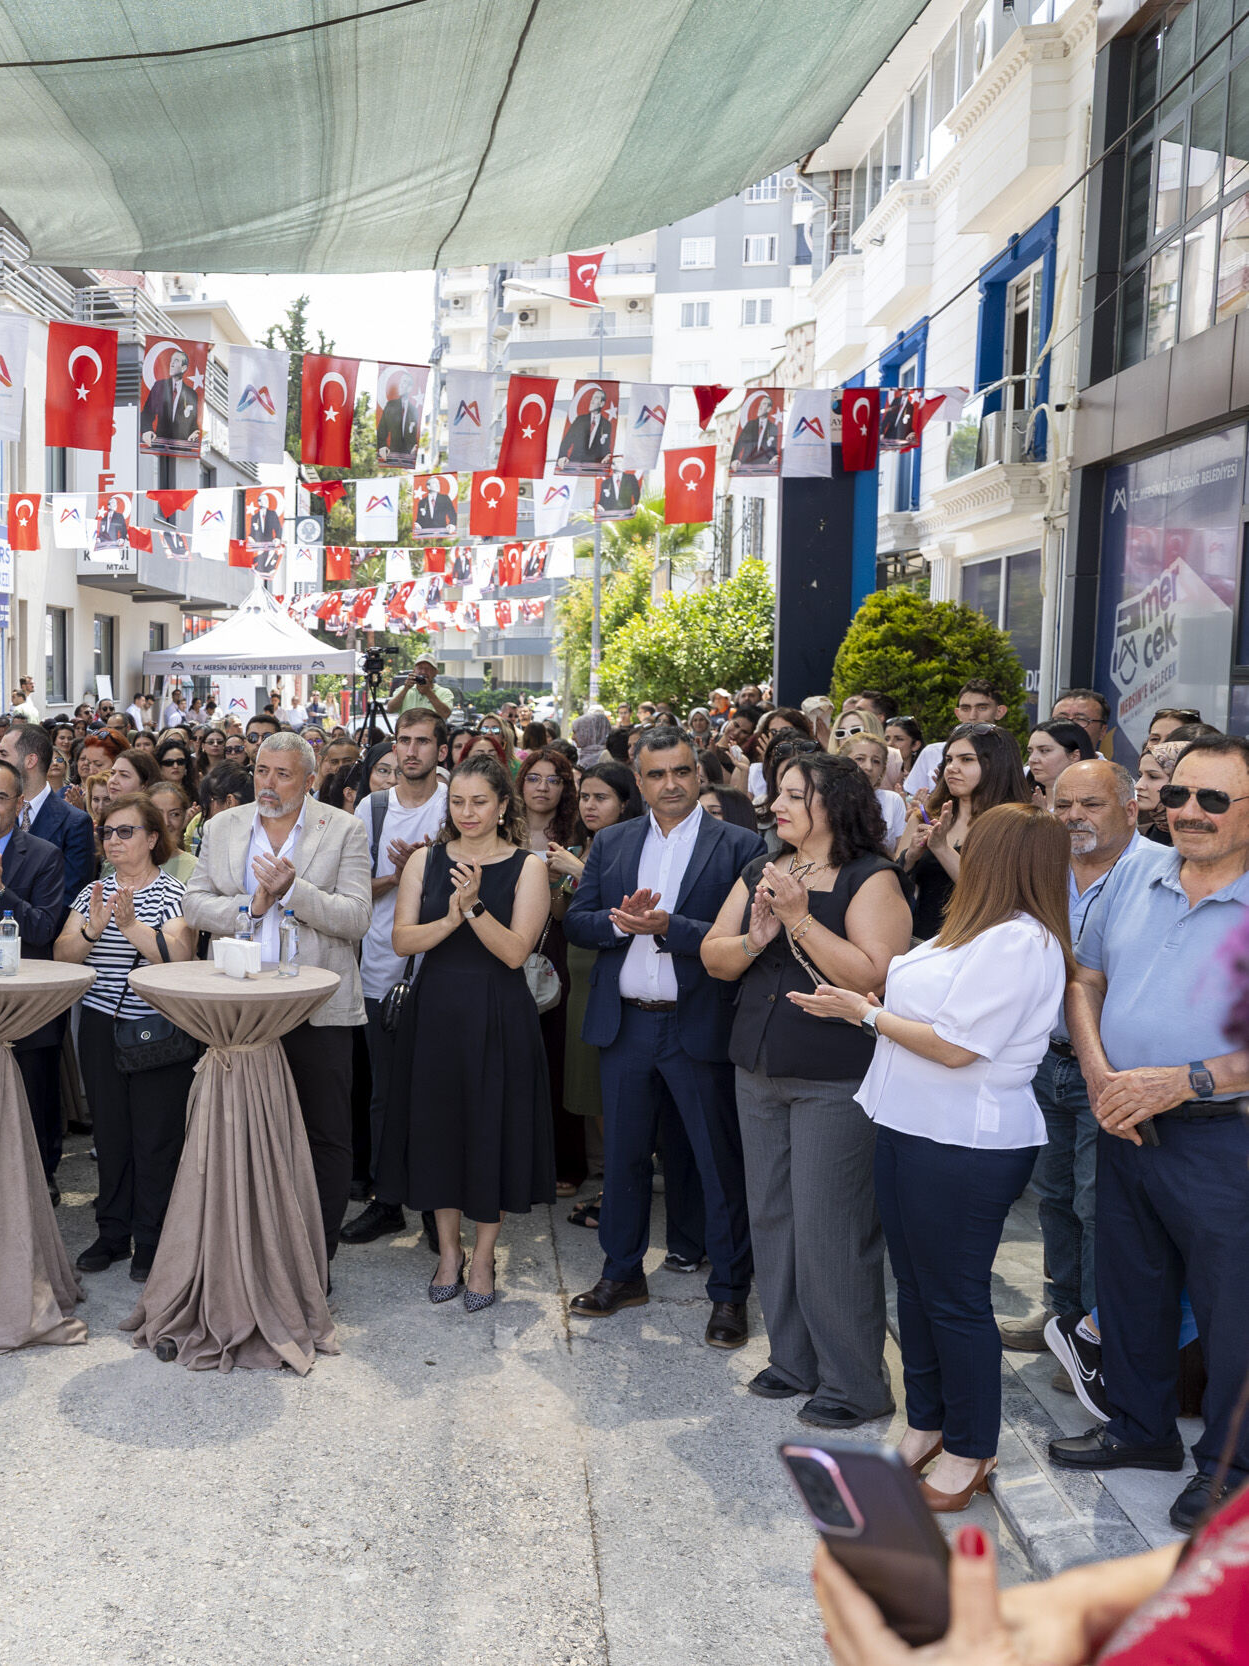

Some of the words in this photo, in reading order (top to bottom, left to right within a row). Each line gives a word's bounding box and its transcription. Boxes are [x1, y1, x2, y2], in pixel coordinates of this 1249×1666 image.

[1201, 459, 1239, 485] BELEDİYESİ
[106, 563, 130, 571] MTAL
[1143, 613, 1178, 668] cek
[228, 664, 268, 672] BÜYÜKŞEHİR
[268, 663, 303, 671] BELEDİYESİ
